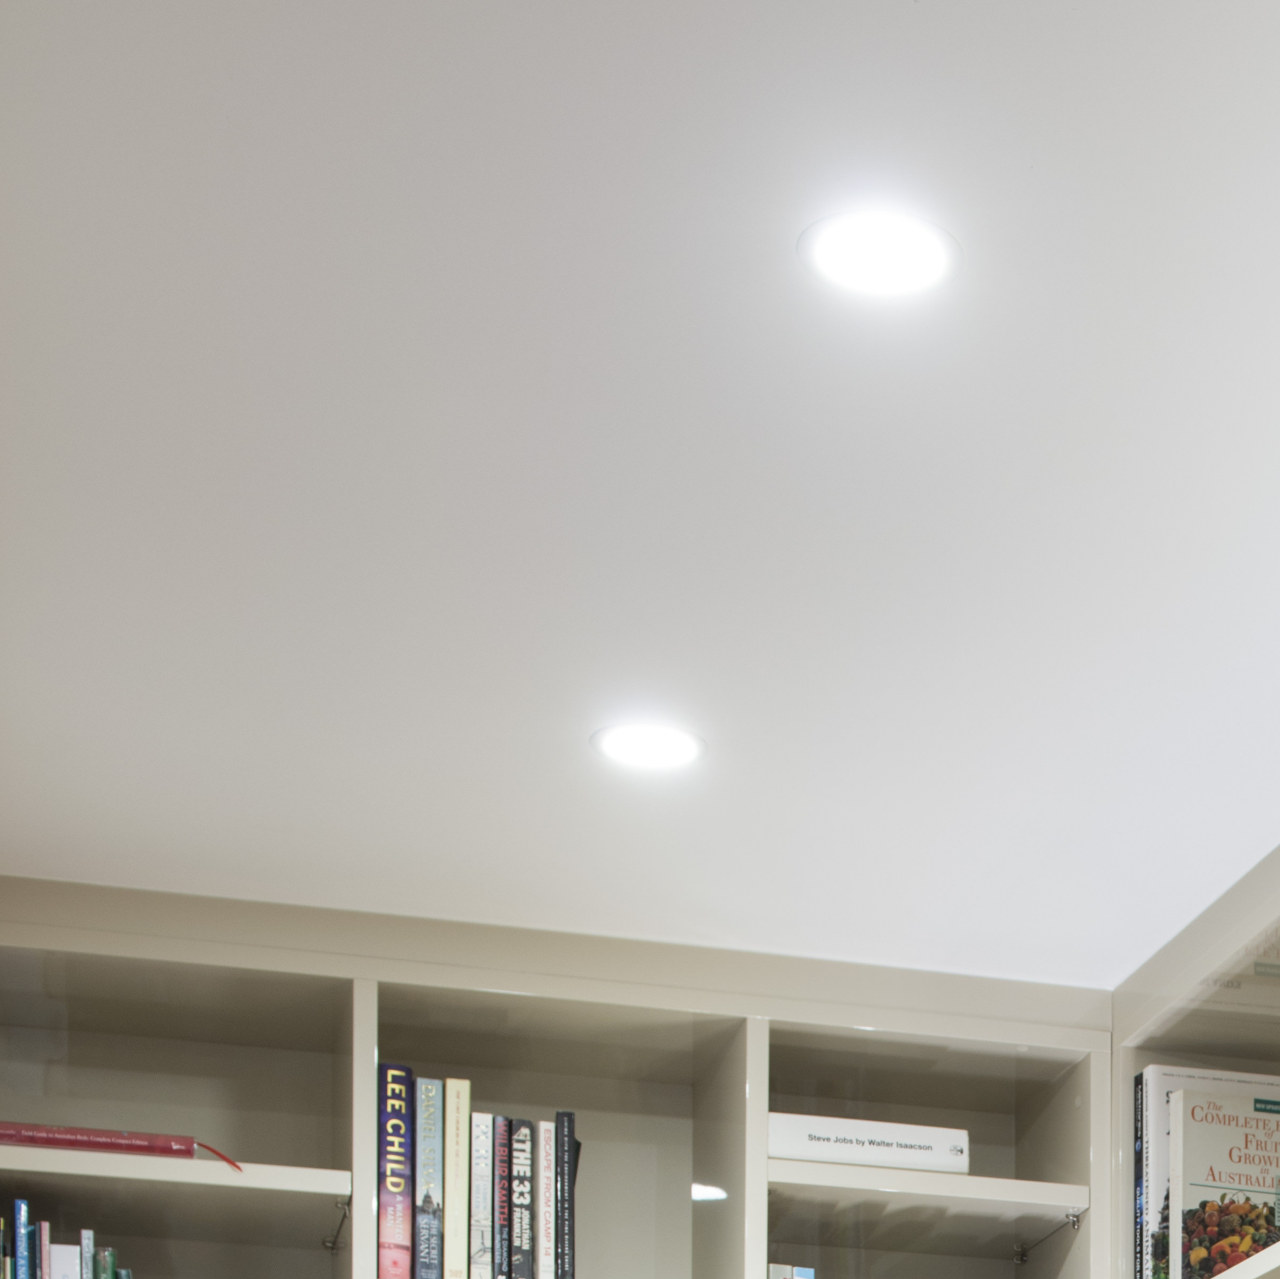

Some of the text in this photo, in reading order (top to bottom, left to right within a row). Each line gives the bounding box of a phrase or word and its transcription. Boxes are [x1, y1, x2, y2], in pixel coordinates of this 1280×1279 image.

[1191, 1104, 1271, 1130] COMPLETE
[1207, 1101, 1223, 1111] The
[385, 1069, 406, 1193] LEE CHILD
[421, 1084, 436, 1190] DANIEL SILVA
[807, 1133, 933, 1151] Steve Jobs by Walter Isaacson
[1264, 1130, 1274, 1139] of
[495, 1121, 508, 1225] WILBUR SMITH
[512, 1141, 530, 1205] THE 33
[1260, 1166, 1270, 1175] in
[543, 1129, 552, 1256] ESCAPE FROM CAMP 14
[419, 1218, 429, 1264] SERVANT
[513, 1207, 521, 1246] FRANKLIN
[521, 1208, 530, 1250] JONATHAN
